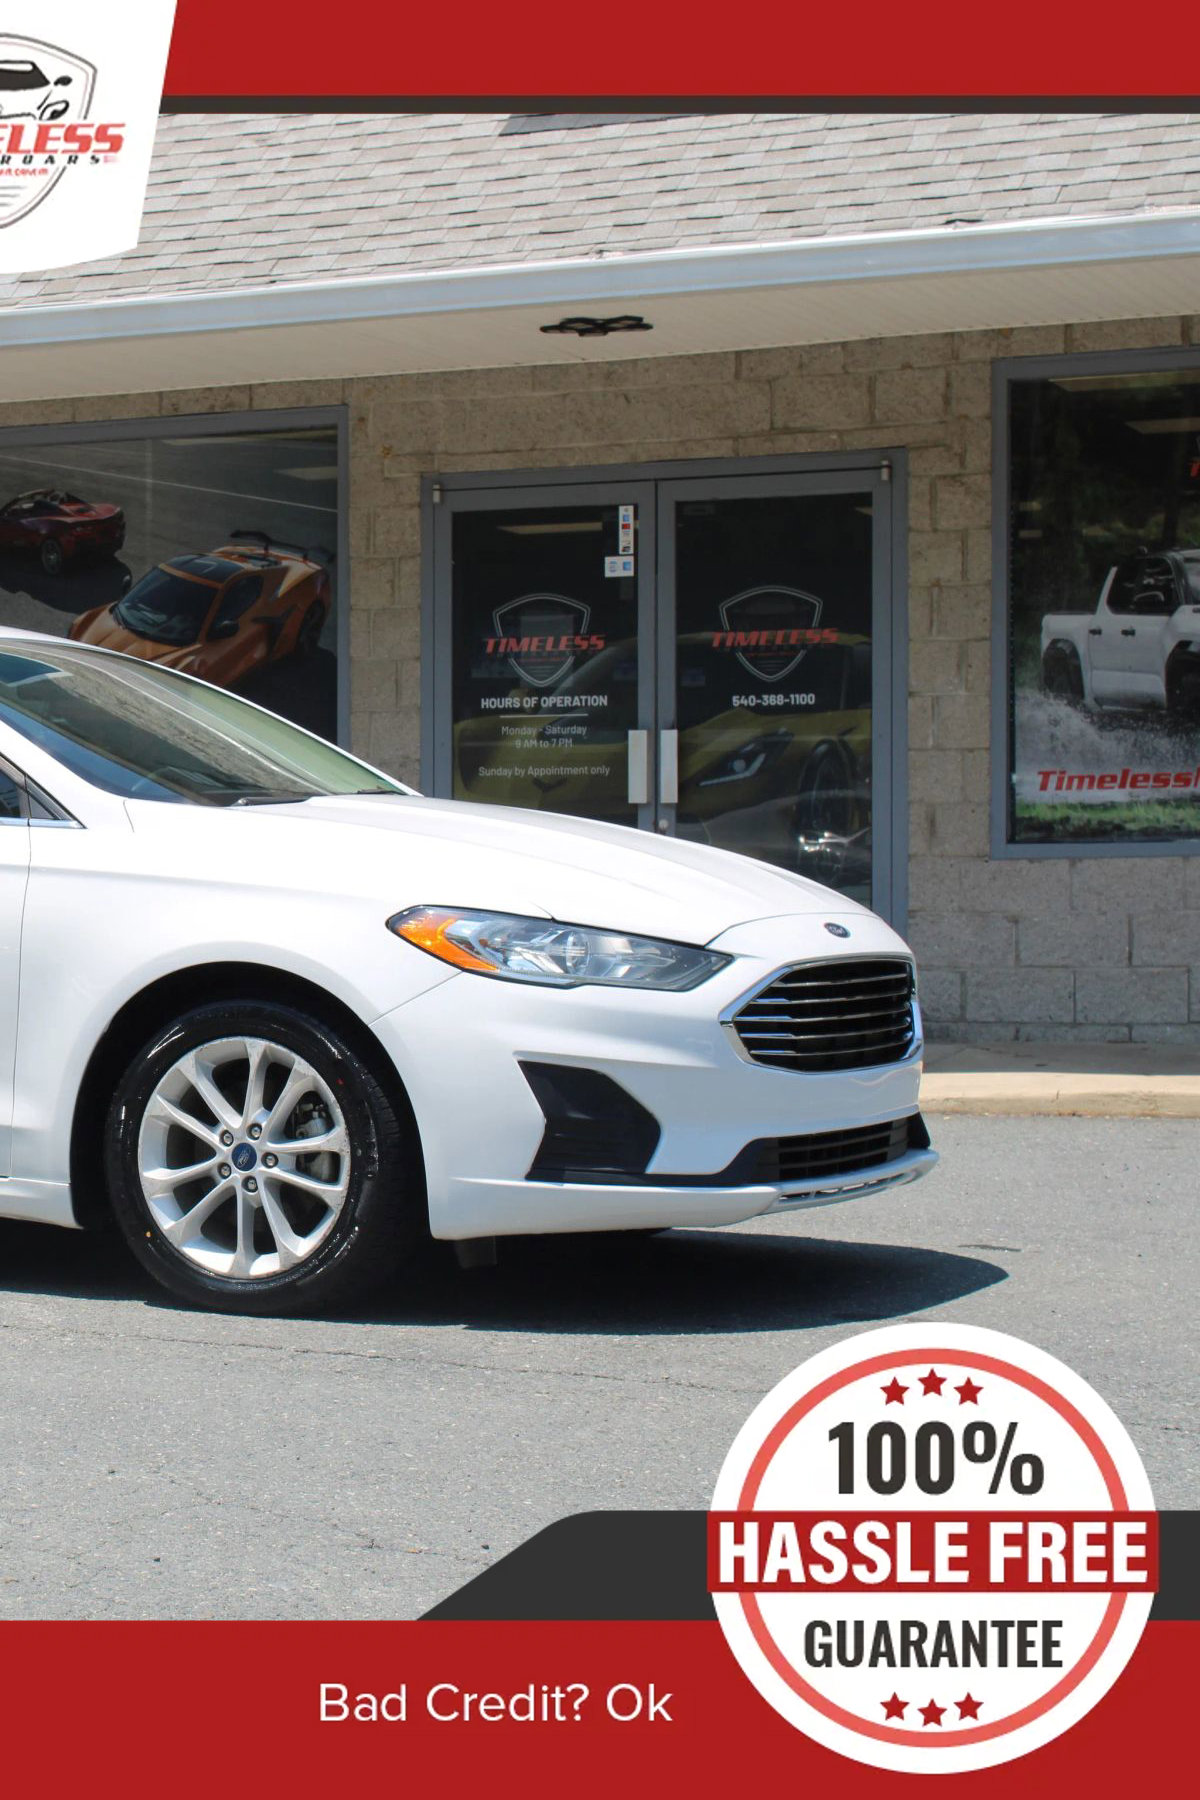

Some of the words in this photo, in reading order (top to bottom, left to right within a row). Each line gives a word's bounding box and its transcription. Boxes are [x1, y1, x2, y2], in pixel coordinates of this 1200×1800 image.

[483, 634, 606, 653] TIMELESS
[712, 628, 839, 647] TIMELESS
[480, 697, 521, 709] HOURS
[522, 696, 539, 708] OF
[540, 695, 608, 708] OPERATION
[732, 693, 816, 707] 540-368-1100
[501, 726, 538, 737] Monday
[544, 725, 588, 736] Saturday
[523, 739, 538, 748] AM
[539, 739, 550, 748] to
[559, 738, 573, 748] PM
[478, 766, 513, 777] Sunday
[514, 766, 526, 777] by
[527, 765, 589, 777] Appointment
[590, 765, 611, 776] only
[1037, 767, 1200, 791] Timeless
